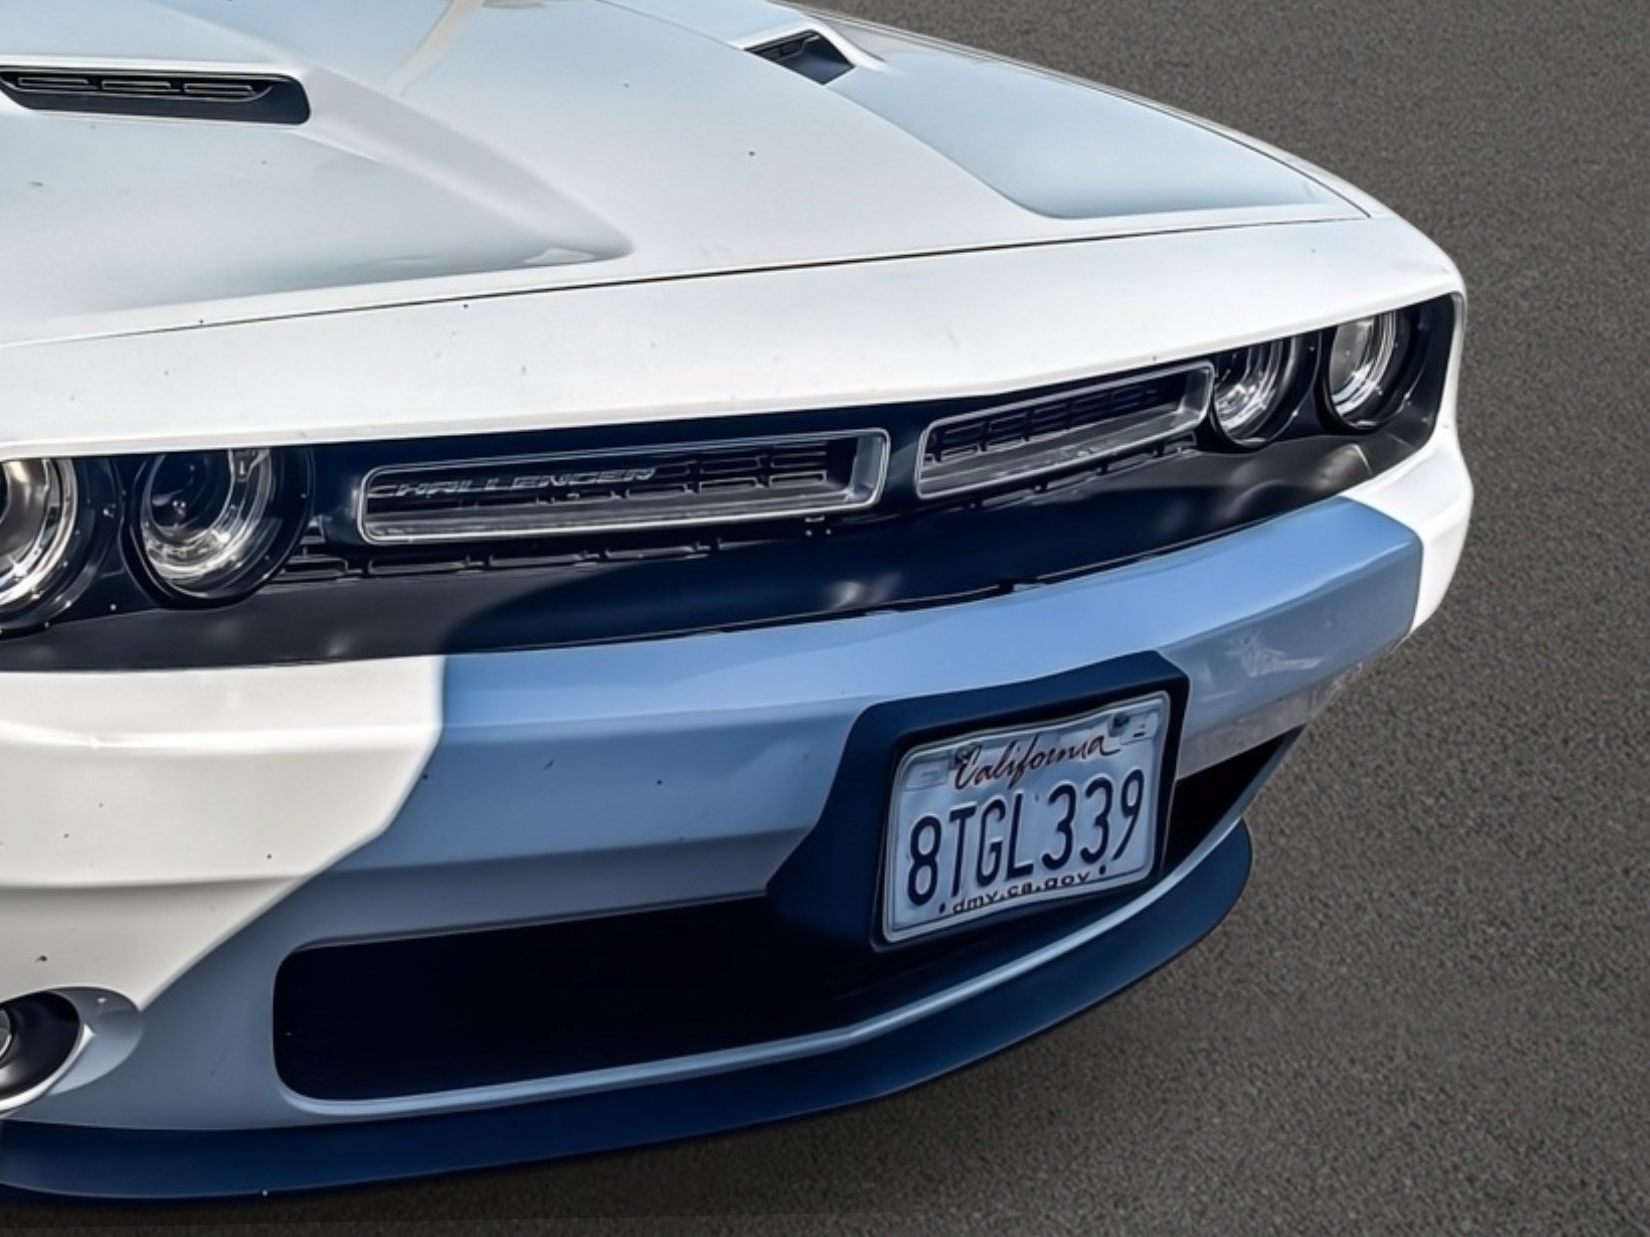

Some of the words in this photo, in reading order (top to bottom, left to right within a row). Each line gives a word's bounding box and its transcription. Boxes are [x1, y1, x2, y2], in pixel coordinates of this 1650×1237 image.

[367, 467, 656, 499] CHALLENGER
[952, 732, 1123, 790] California
[906, 768, 1146, 906] 8TGL339
[951, 870, 1092, 915] dmv.ca.gov
